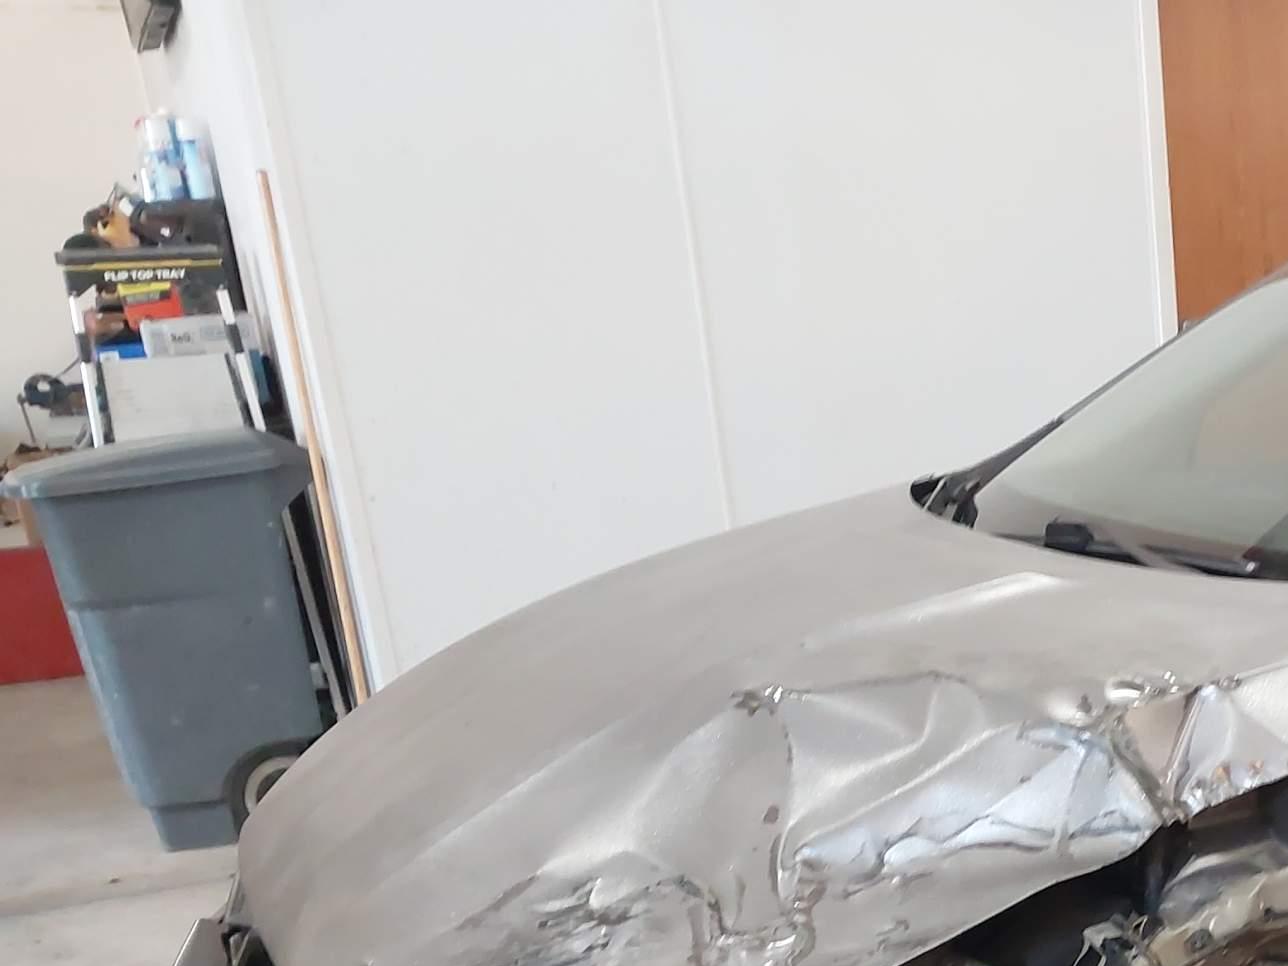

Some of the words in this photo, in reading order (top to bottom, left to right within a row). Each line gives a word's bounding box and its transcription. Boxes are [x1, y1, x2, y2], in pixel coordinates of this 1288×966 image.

[103, 269, 128, 282] FLIP
[130, 269, 155, 281] TOP
[156, 267, 186, 281] TRAY
